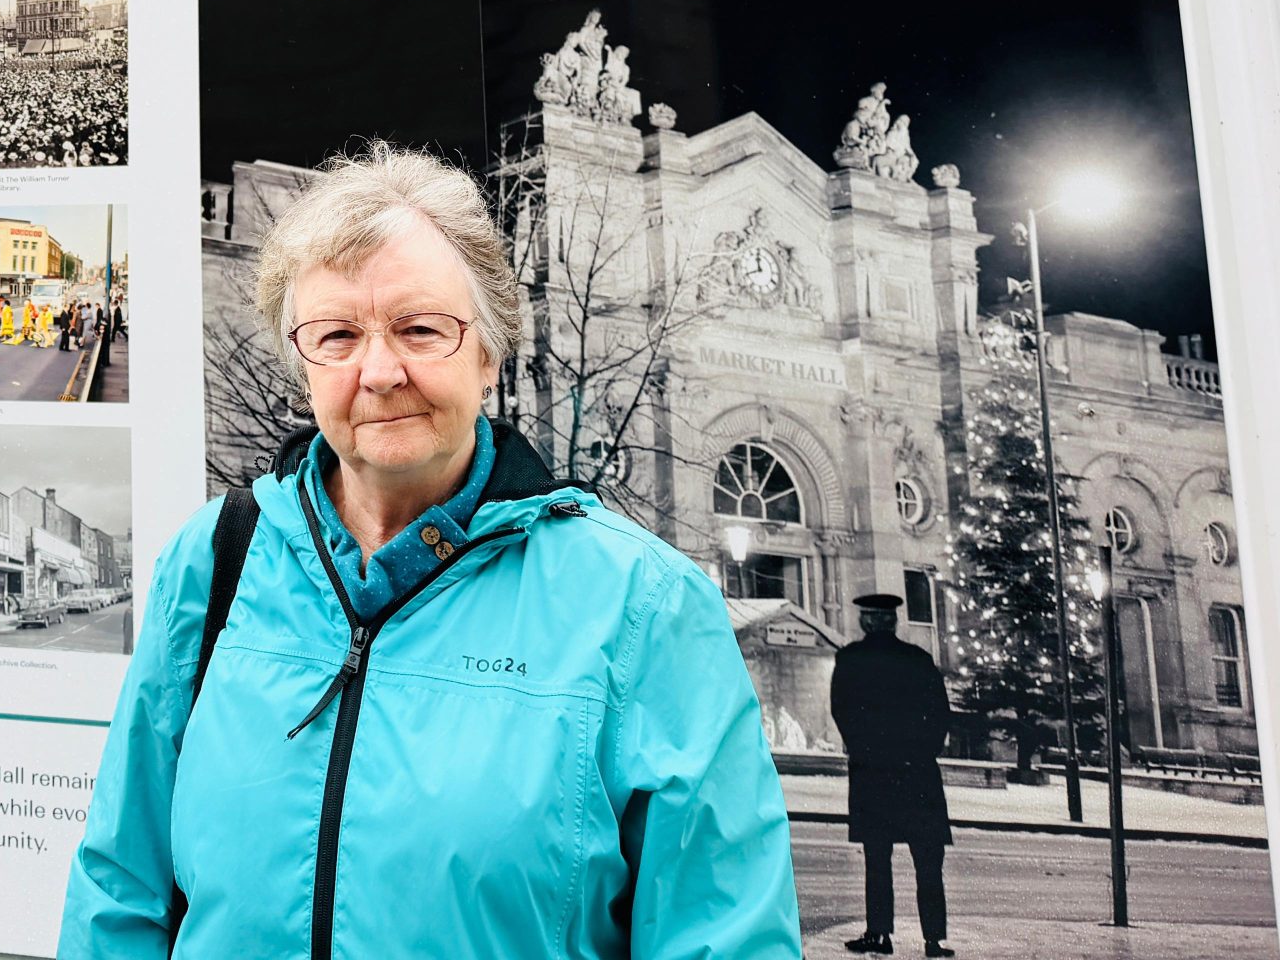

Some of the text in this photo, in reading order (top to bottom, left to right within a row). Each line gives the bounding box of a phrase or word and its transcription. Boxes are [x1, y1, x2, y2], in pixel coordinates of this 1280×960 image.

[698, 346, 844, 386] MARKET HALL
[462, 655, 527, 677] TOG24
